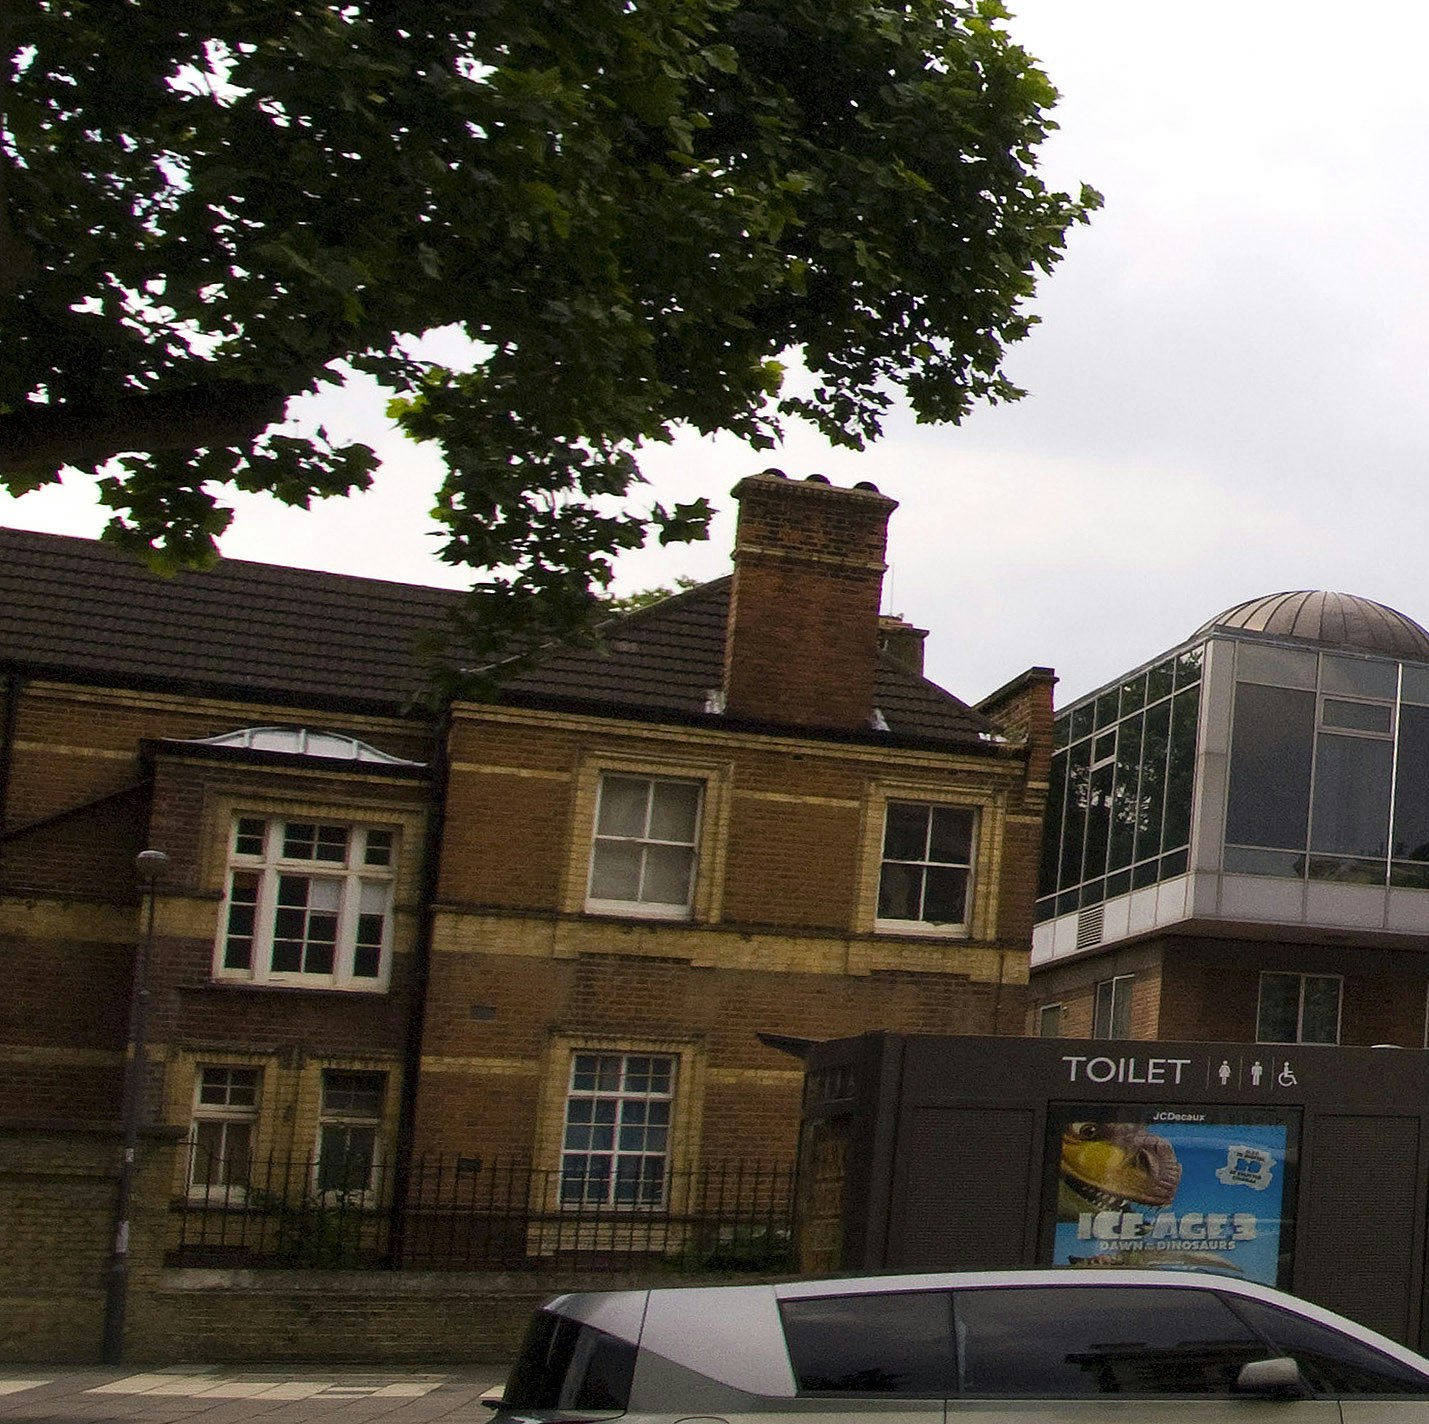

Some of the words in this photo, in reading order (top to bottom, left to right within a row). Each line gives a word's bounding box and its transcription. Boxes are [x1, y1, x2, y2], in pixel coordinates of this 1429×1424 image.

[1062, 1056, 1191, 1084] TOILET
[1153, 1111, 1207, 1122] JCDecaux
[1078, 1211, 1145, 1240] ICE
[1151, 1211, 1229, 1240] AGE
[1232, 1212, 1258, 1241] 3
[1100, 1240, 1144, 1251] DAWN
[1157, 1240, 1237, 1251] DINOSAURS
